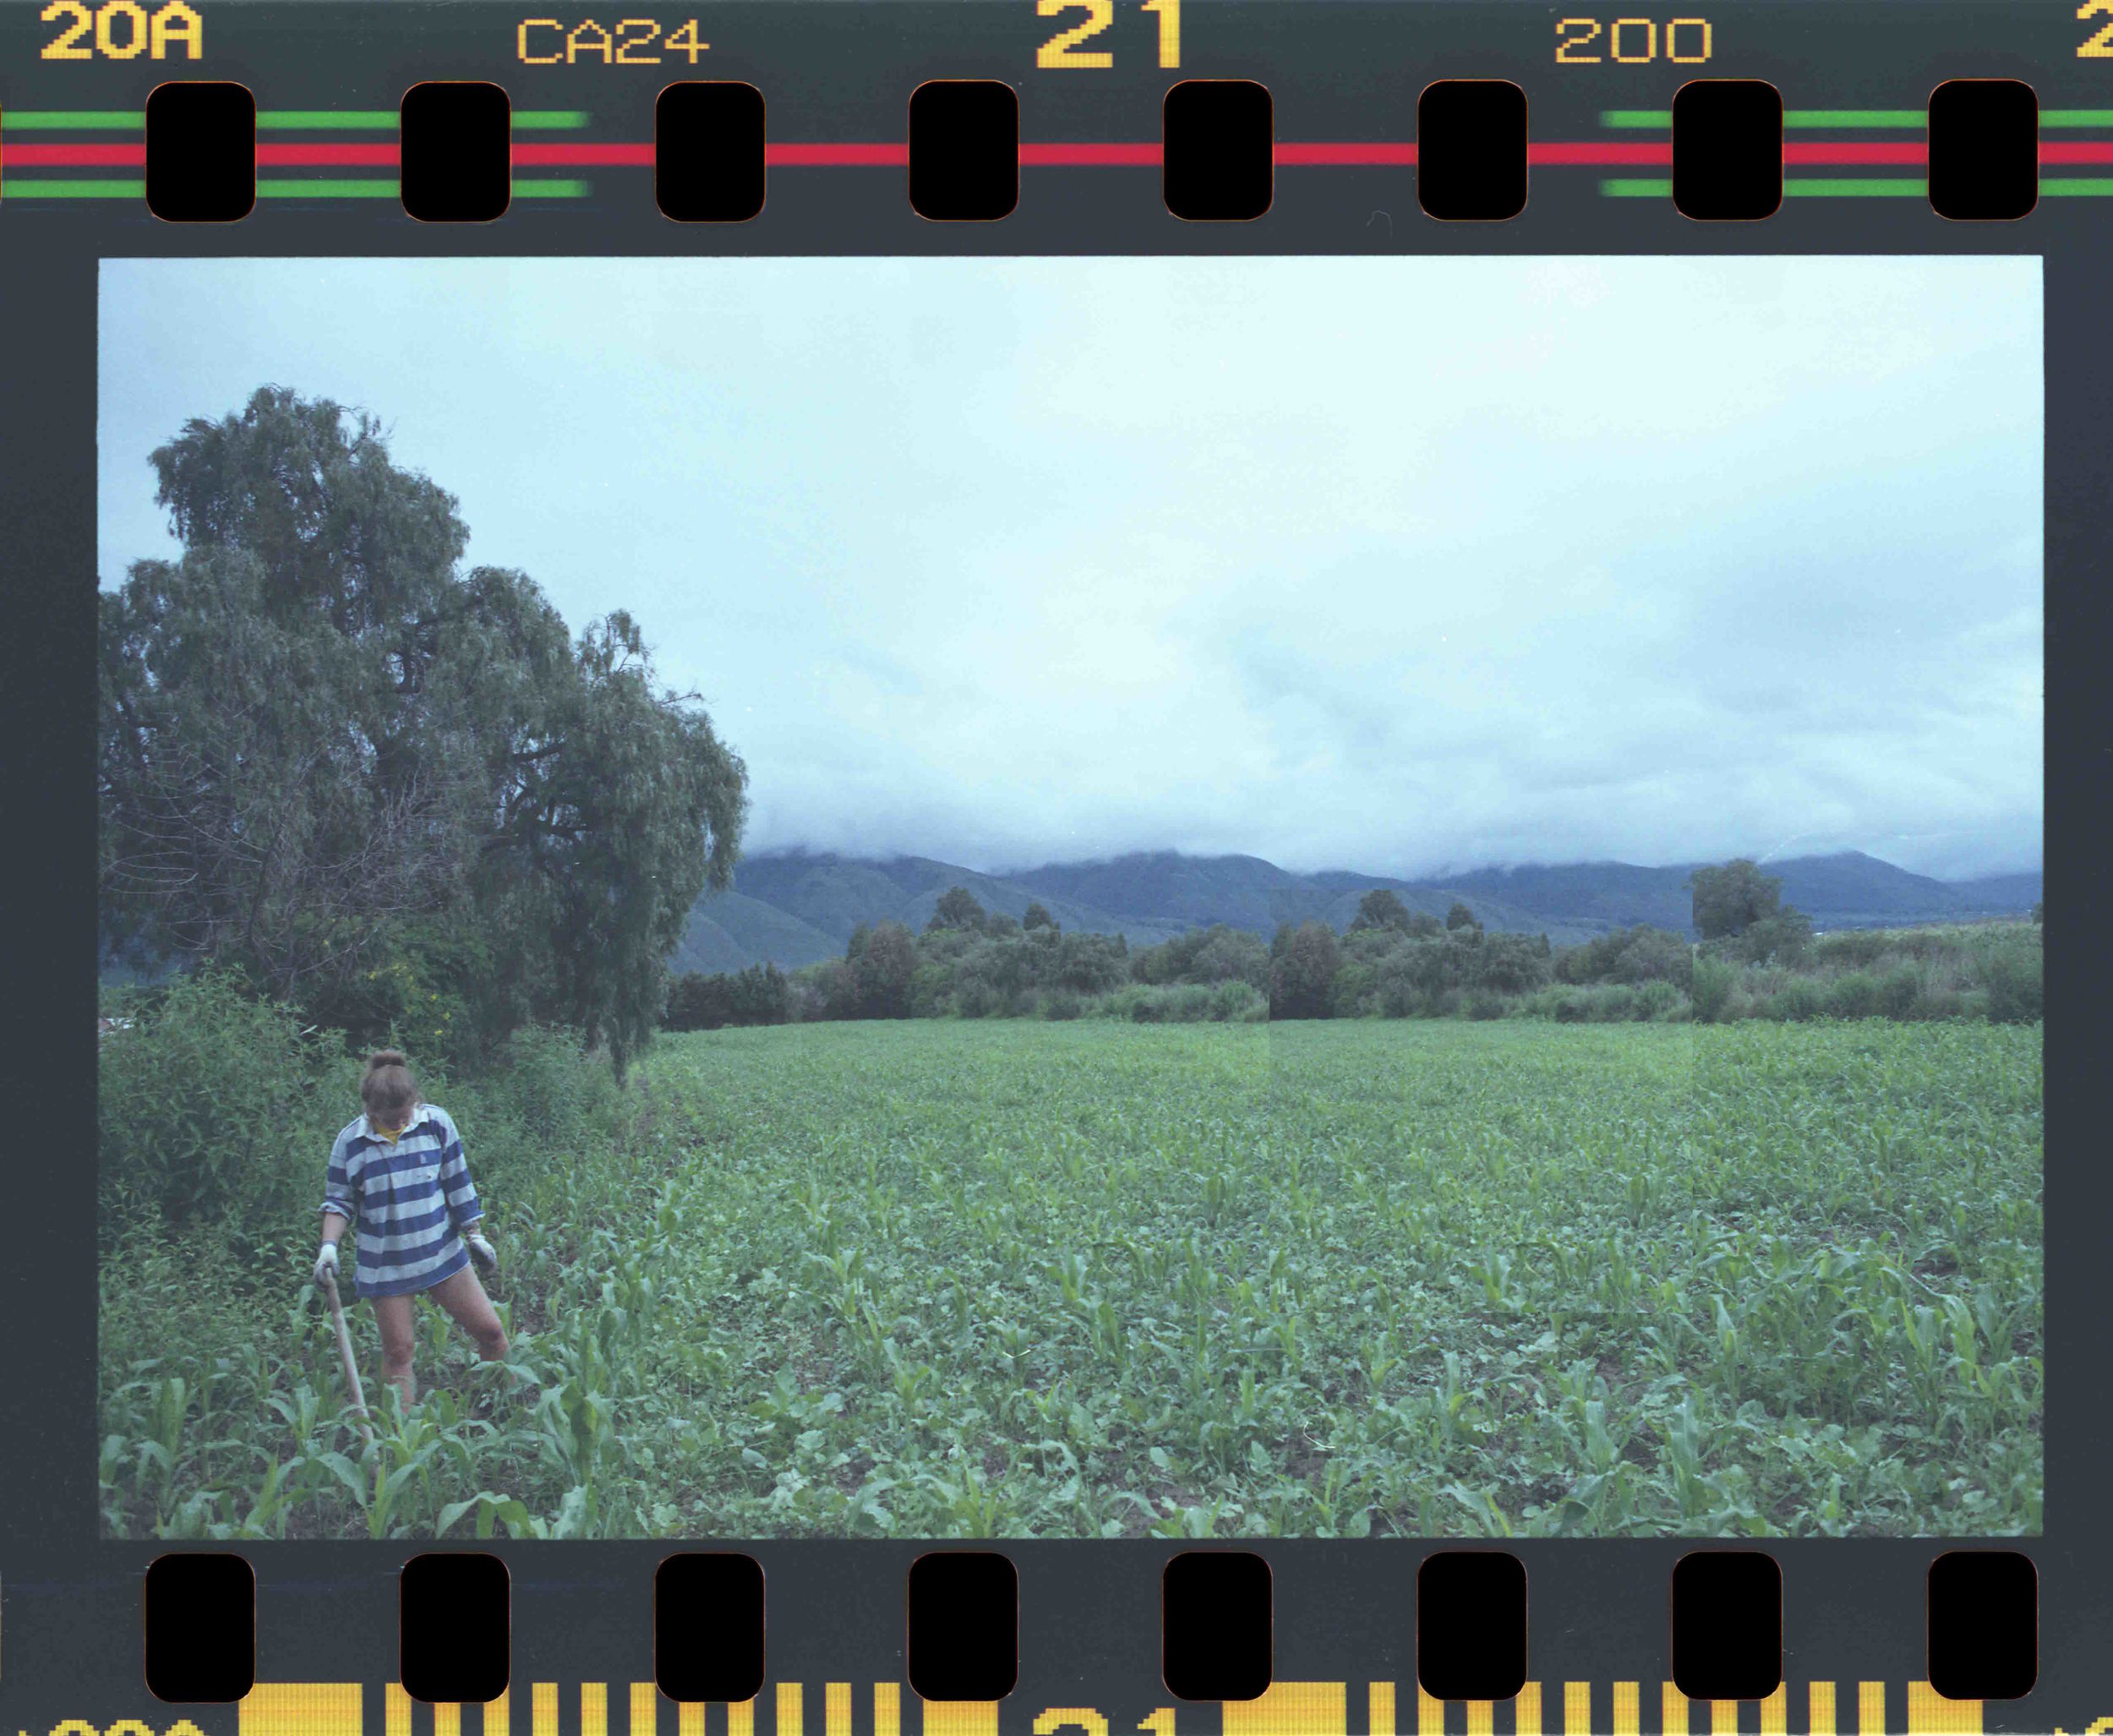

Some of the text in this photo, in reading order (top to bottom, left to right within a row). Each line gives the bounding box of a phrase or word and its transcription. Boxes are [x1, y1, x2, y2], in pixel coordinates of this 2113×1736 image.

[41, 0, 203, 59] 20A
[517, 19, 710, 64] CA24
[1036, 0, 1181, 68] 21
[1555, 18, 1712, 63] 200
